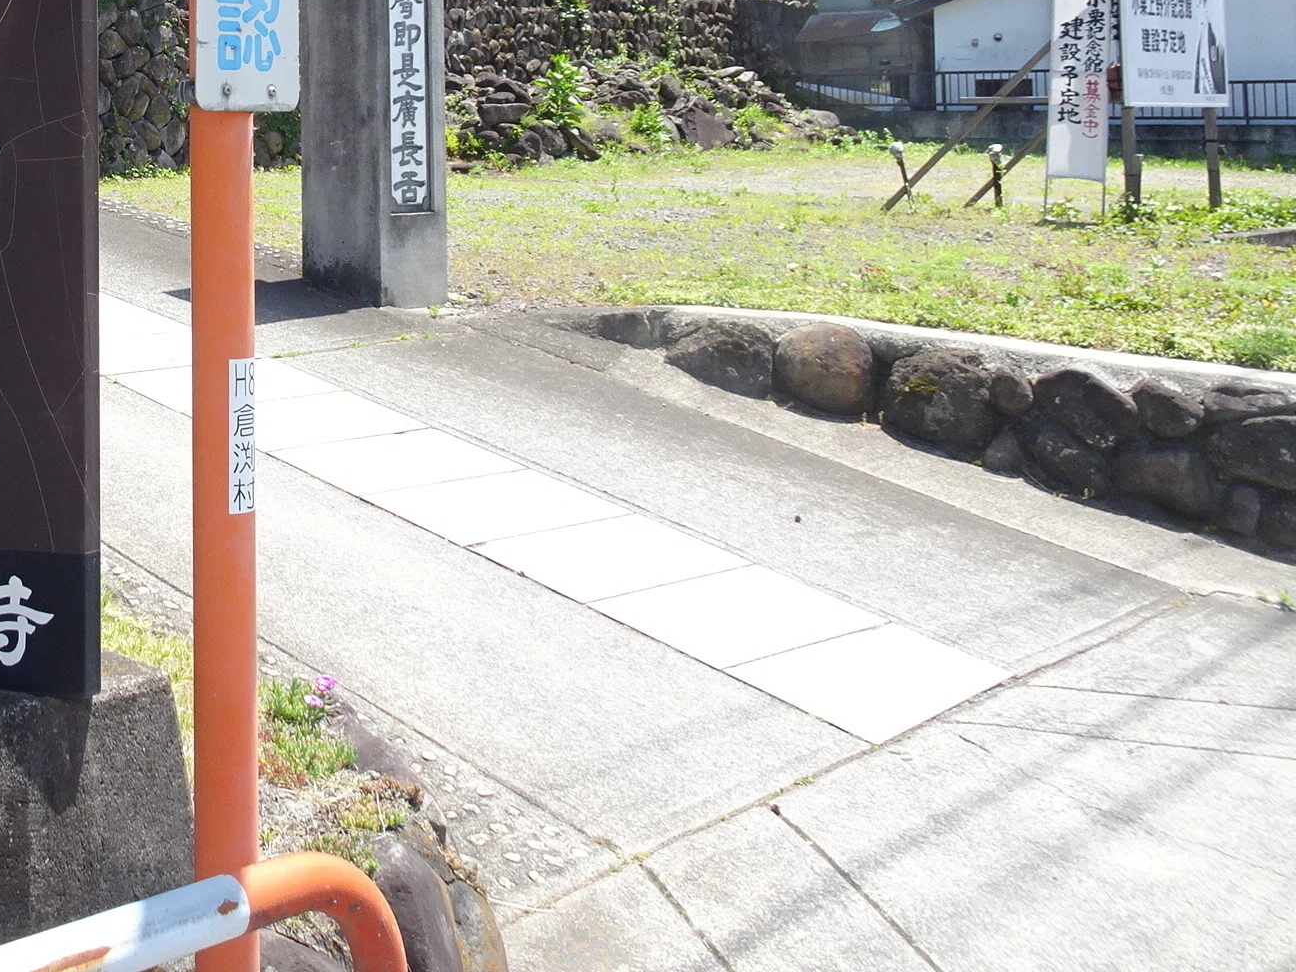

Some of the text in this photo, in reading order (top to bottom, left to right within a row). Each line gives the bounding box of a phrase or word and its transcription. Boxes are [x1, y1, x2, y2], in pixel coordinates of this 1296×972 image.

[1058, 16, 1085, 125] 建設予定地
[1141, 28, 1186, 54] 建設予定地
